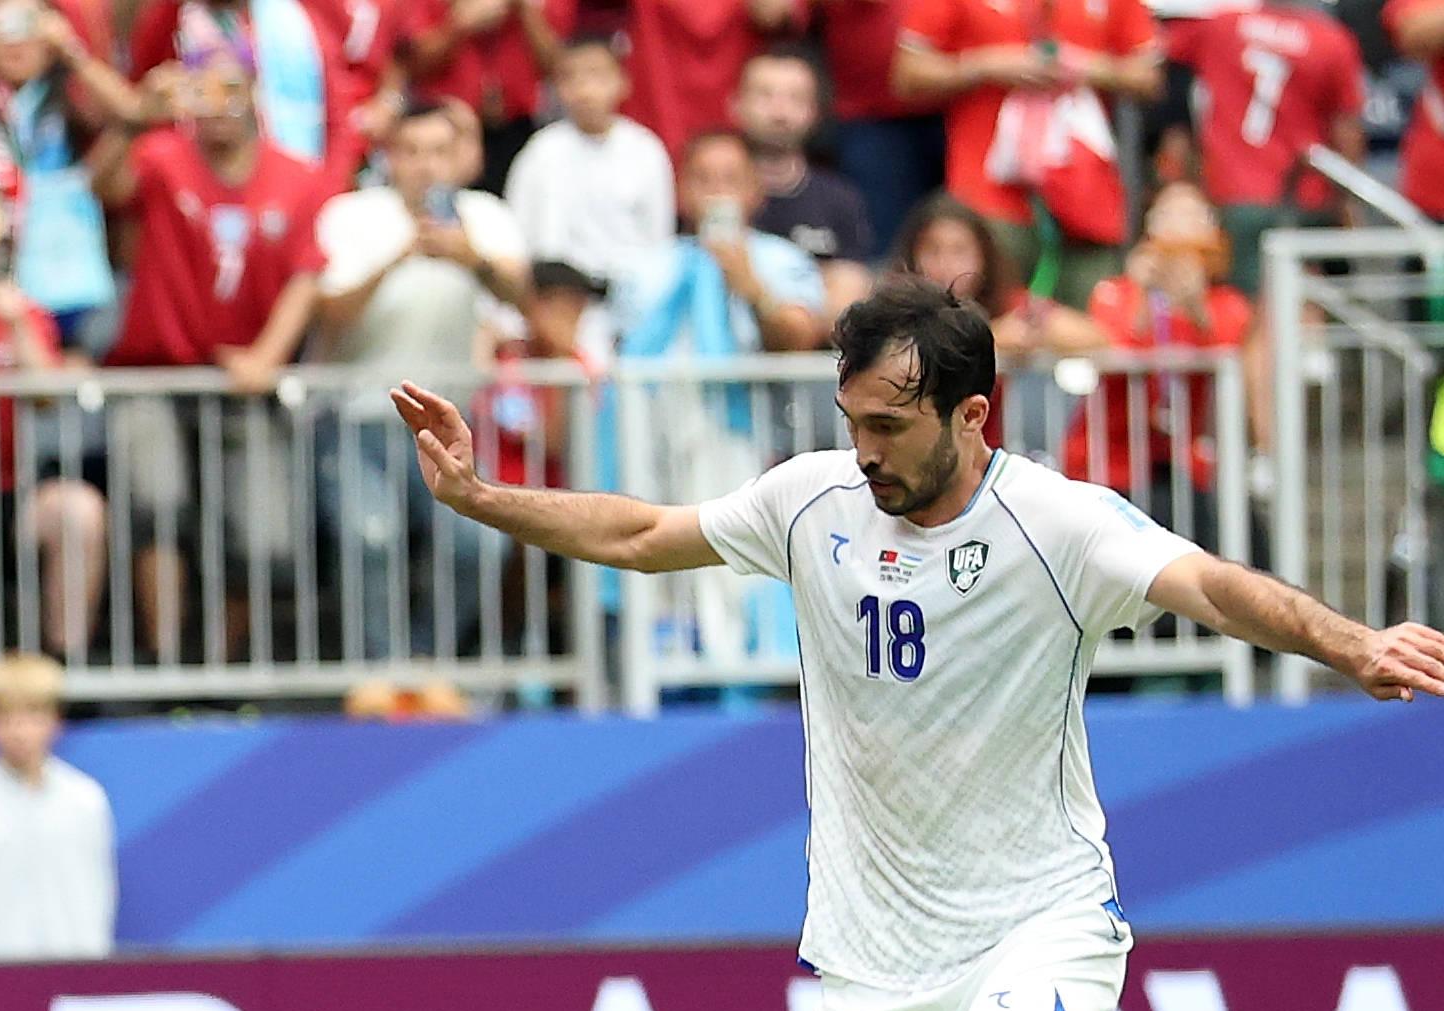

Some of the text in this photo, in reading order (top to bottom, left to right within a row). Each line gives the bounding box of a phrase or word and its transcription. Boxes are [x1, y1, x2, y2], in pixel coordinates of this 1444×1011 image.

[1241, 44, 1290, 148] 7
[953, 545, 984, 570] UFA
[856, 594, 926, 682] 18
